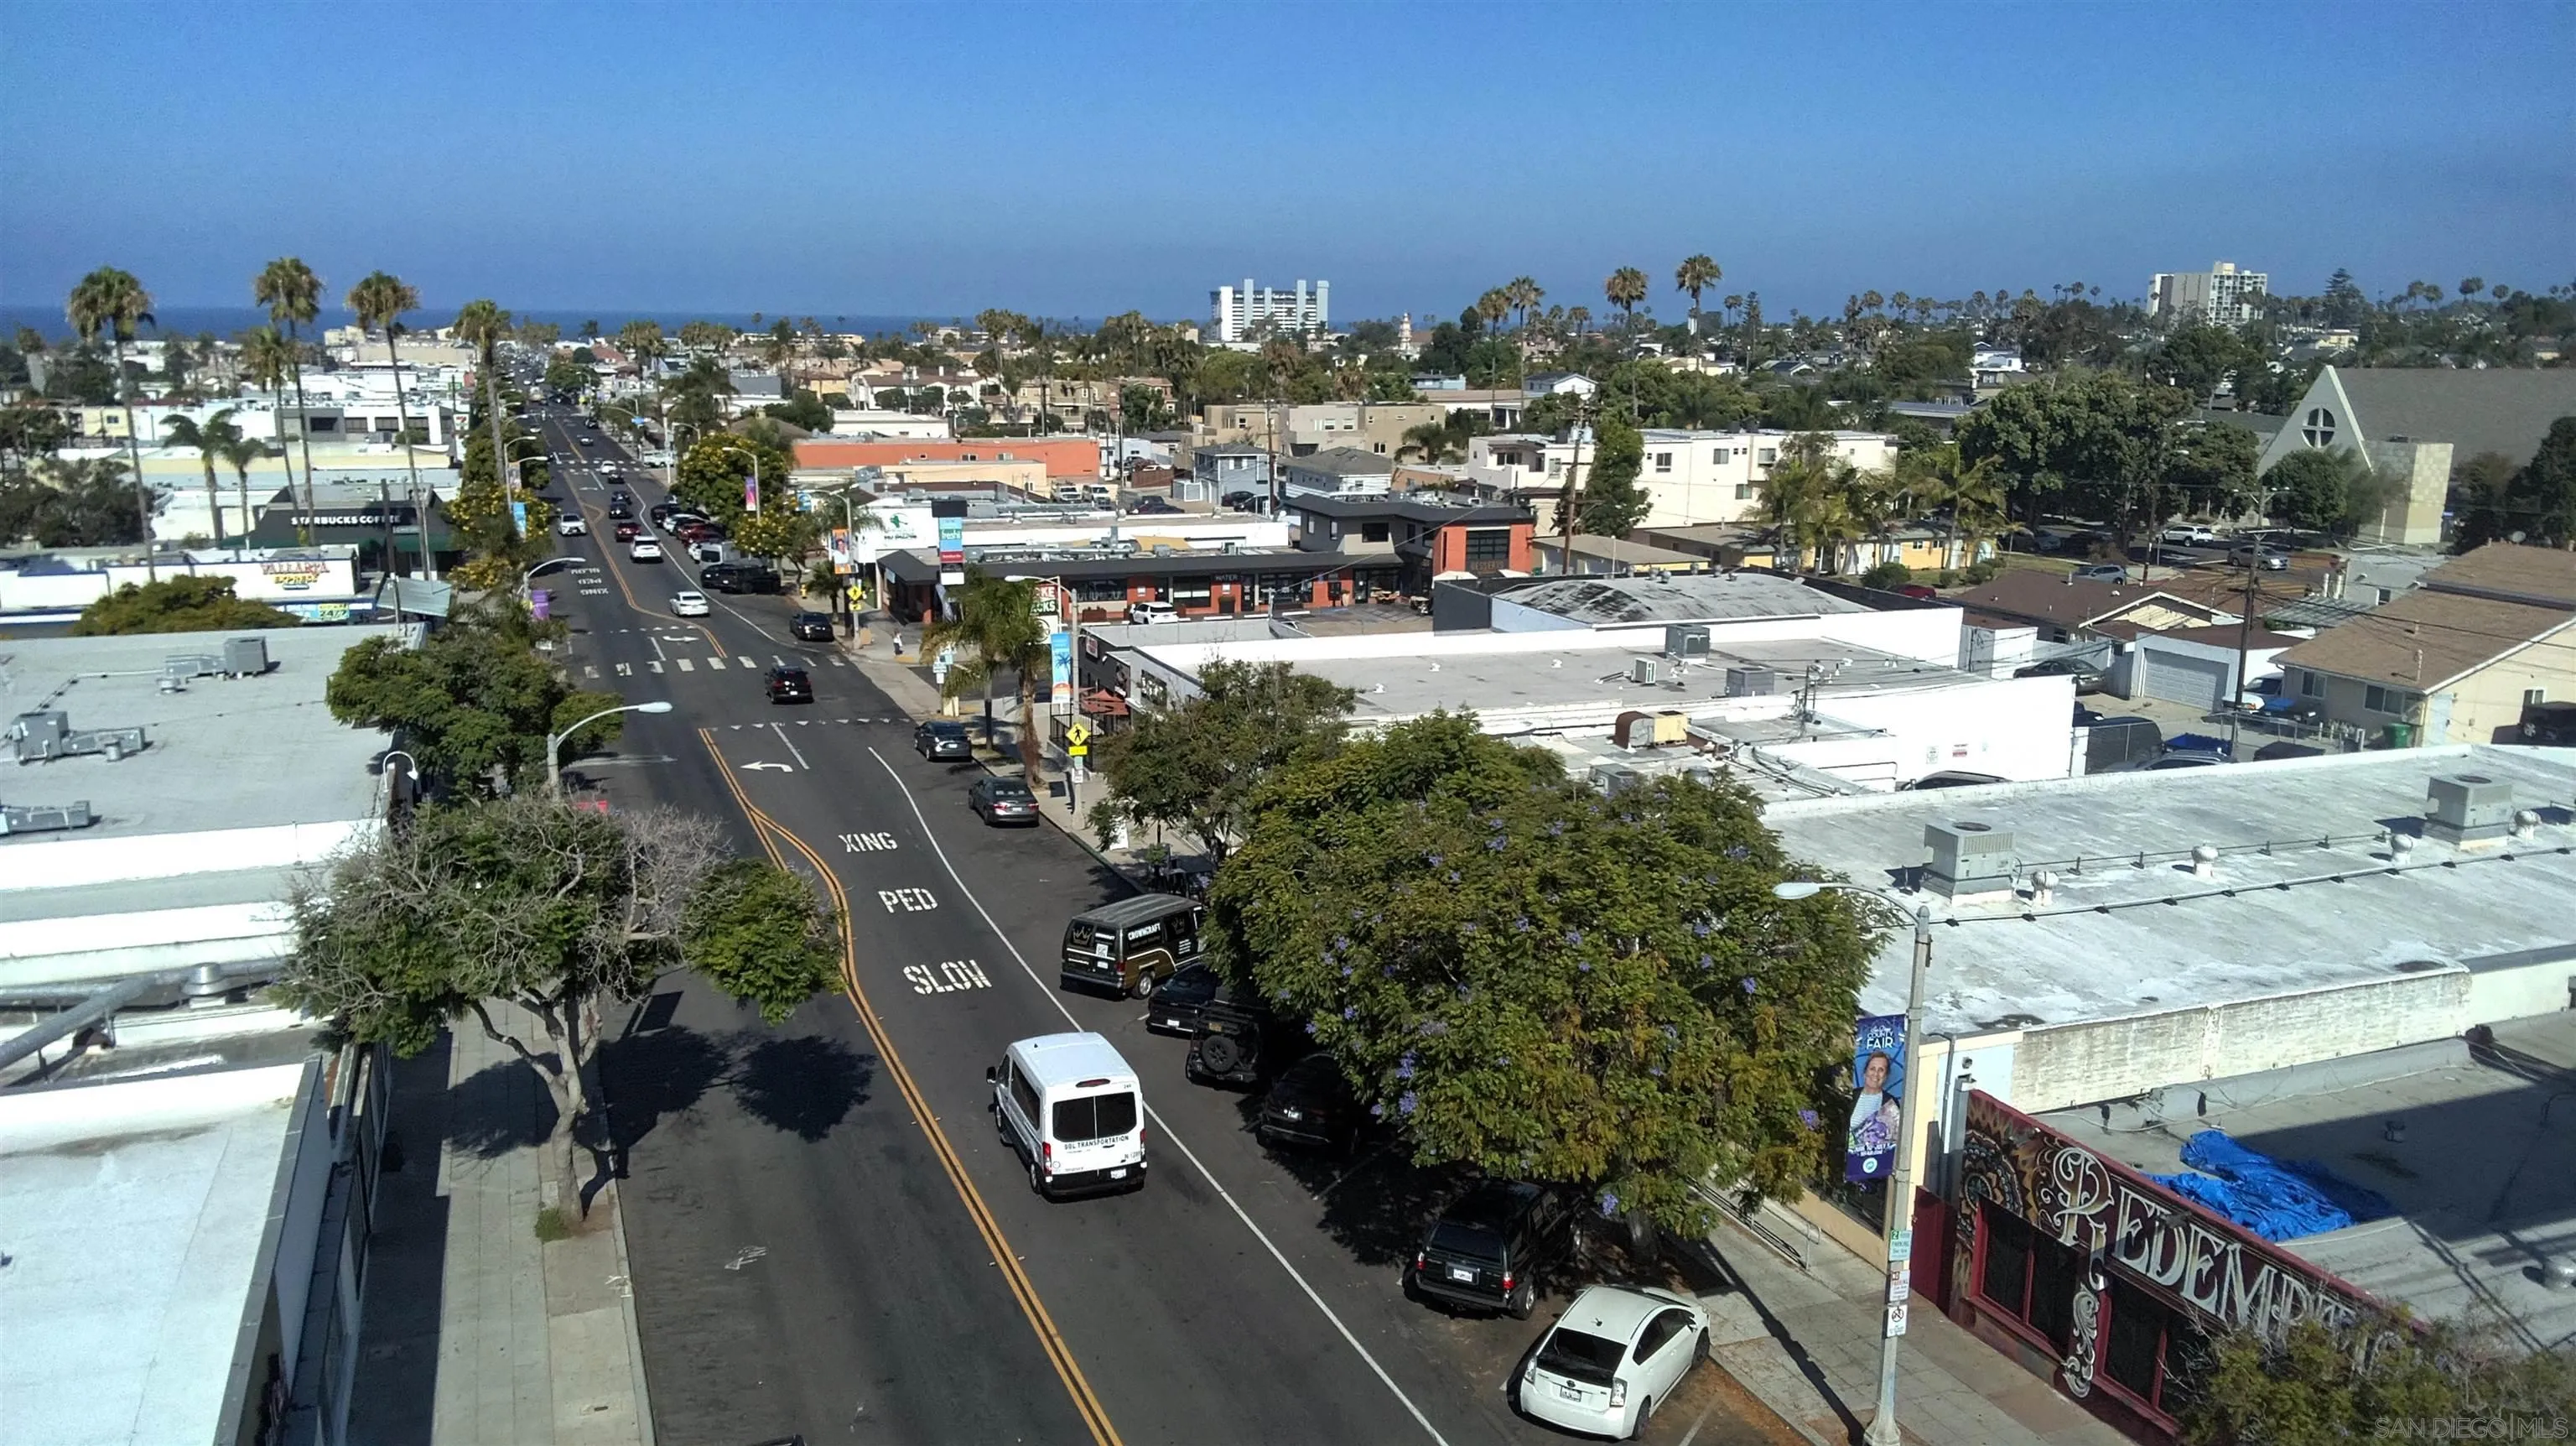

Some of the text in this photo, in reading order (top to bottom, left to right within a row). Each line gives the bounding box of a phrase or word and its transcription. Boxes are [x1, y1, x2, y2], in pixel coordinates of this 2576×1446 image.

[291, 516, 358, 525] STARBUCKS
[839, 831, 898, 853] XING
[878, 887, 938, 913] PED
[902, 959, 993, 996] SLOW
[1867, 1031, 1893, 1040] COUNTY
[1866, 1036, 1893, 1050] FAIR
[1078, 1136, 1129, 1147] TRANSPORTATION
